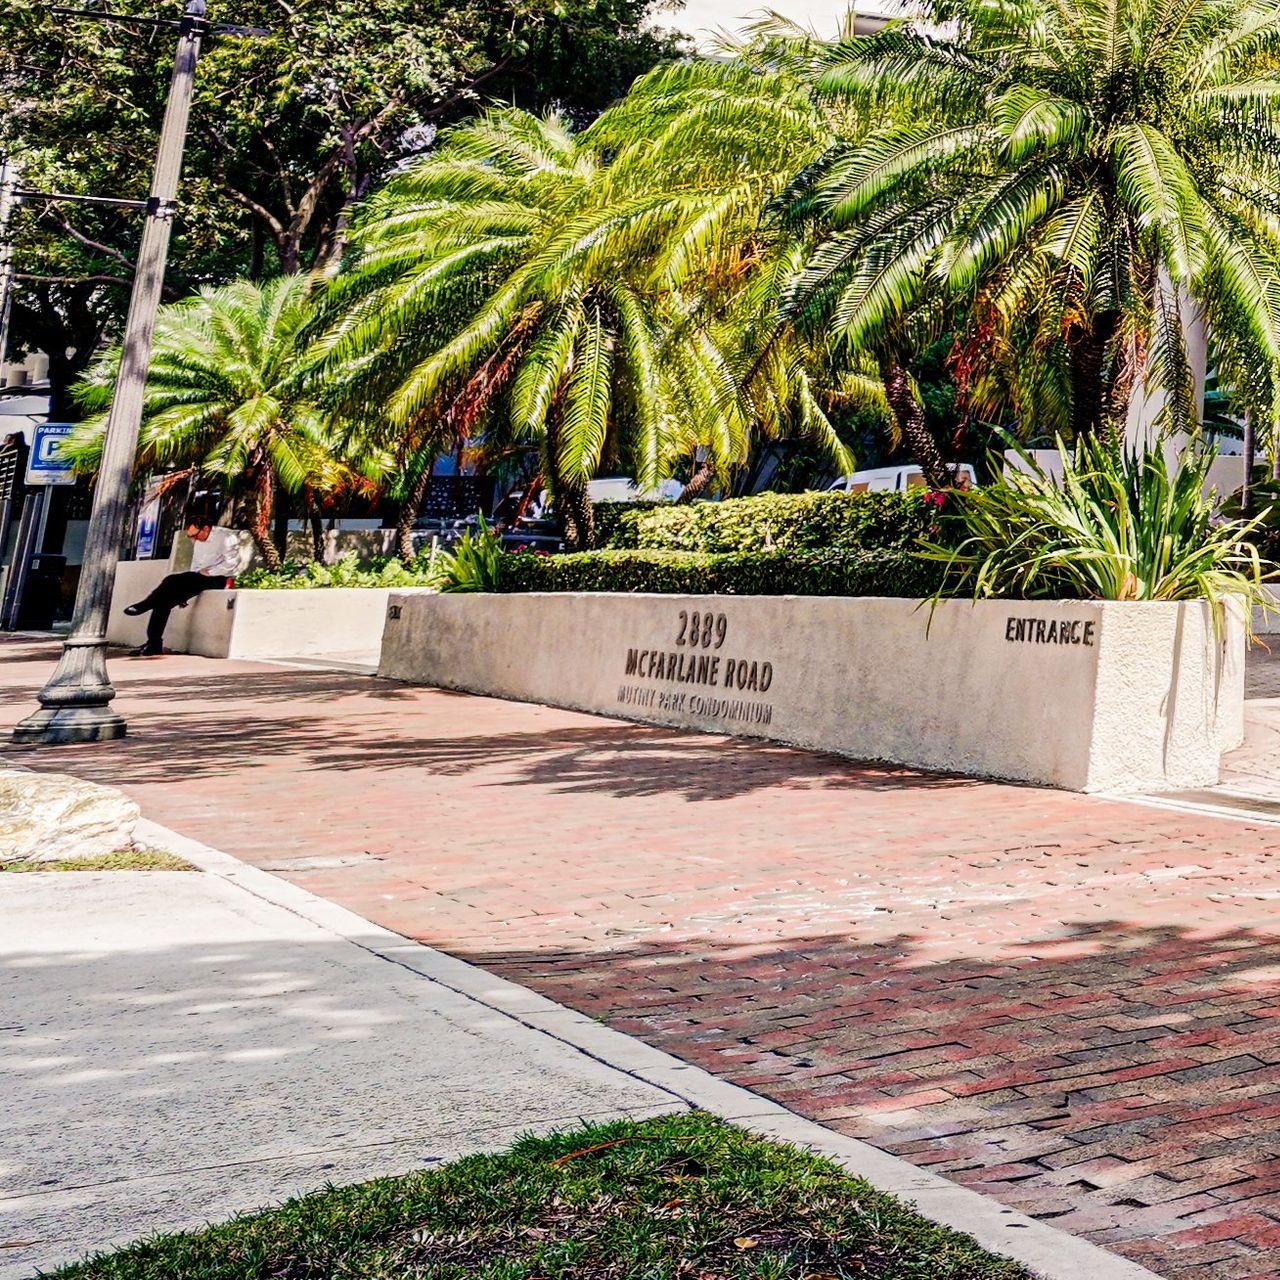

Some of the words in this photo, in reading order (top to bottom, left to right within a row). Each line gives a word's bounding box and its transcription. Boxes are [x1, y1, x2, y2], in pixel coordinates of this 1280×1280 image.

[675, 609, 729, 650] 2889
[1005, 617, 1096, 647] ENTRANCE
[625, 648, 720, 686] MCFARLANE
[724, 658, 774, 693] ROAD
[617, 683, 657, 708] MUTINY
[658, 691, 687, 713] PARK
[689, 696, 774, 725] CONDOMINIUM
